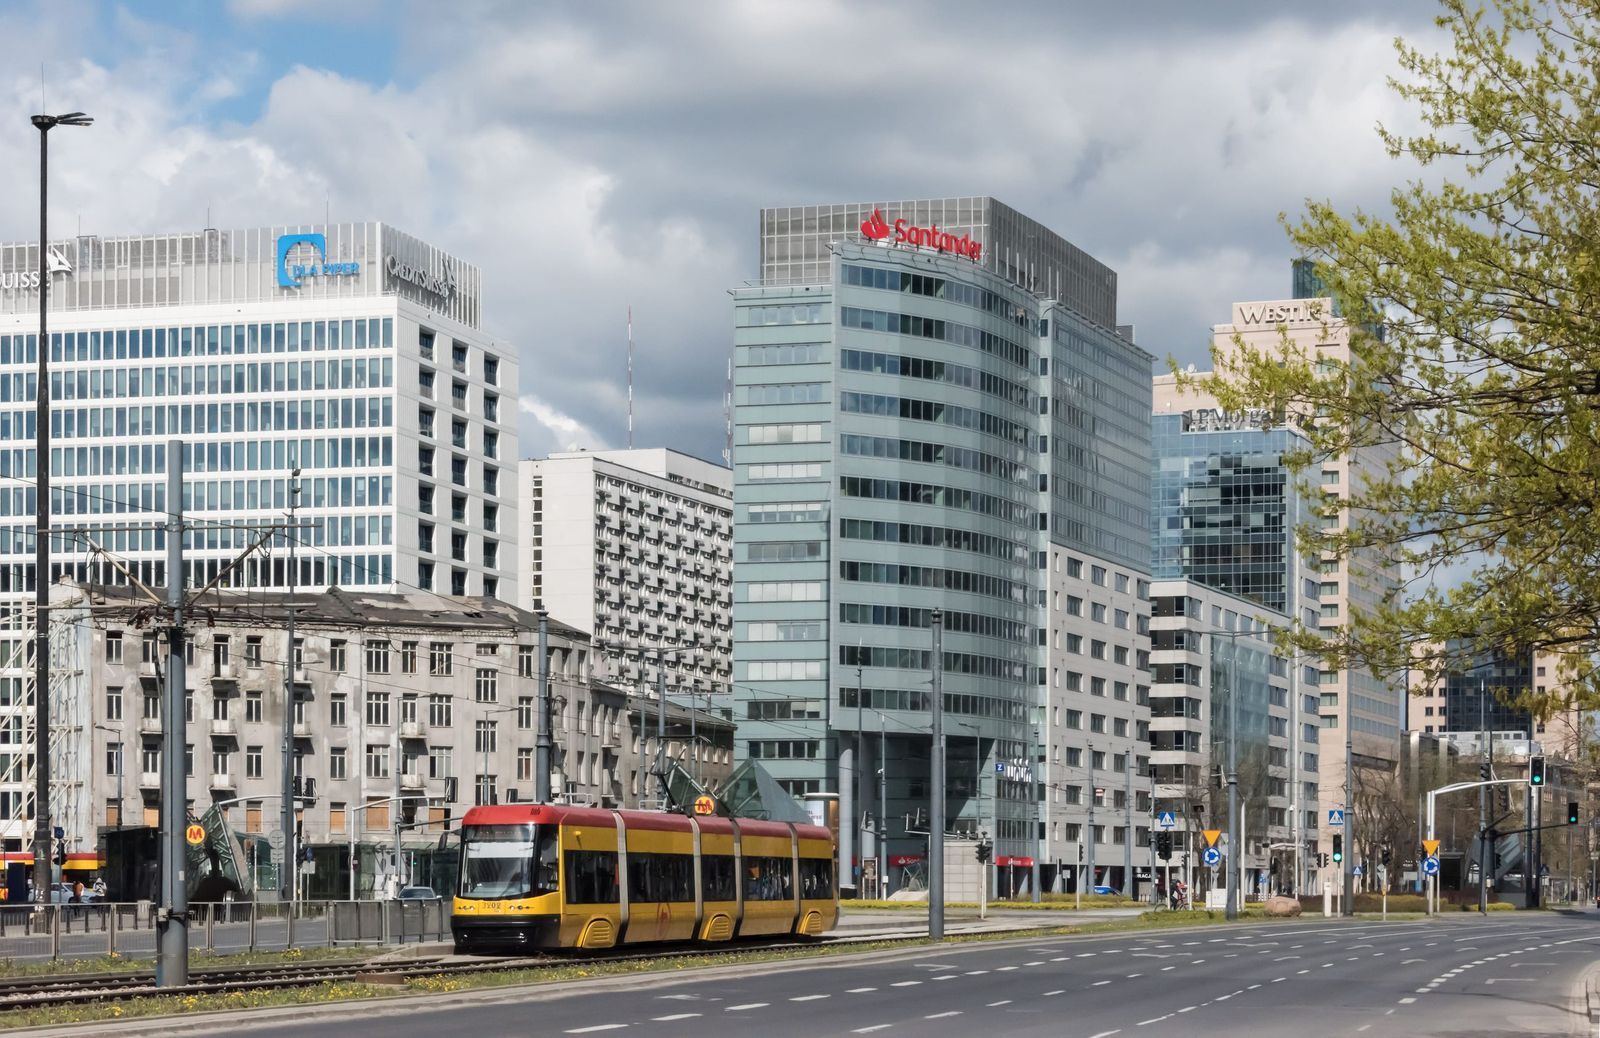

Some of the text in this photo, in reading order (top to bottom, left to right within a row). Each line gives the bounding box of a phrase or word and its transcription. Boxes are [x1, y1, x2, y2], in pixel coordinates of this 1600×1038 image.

[894, 218, 982, 260] Santander
[322, 263, 360, 276] PIPER
[0, 271, 50, 289] UISS
[189, 828, 202, 840] M
